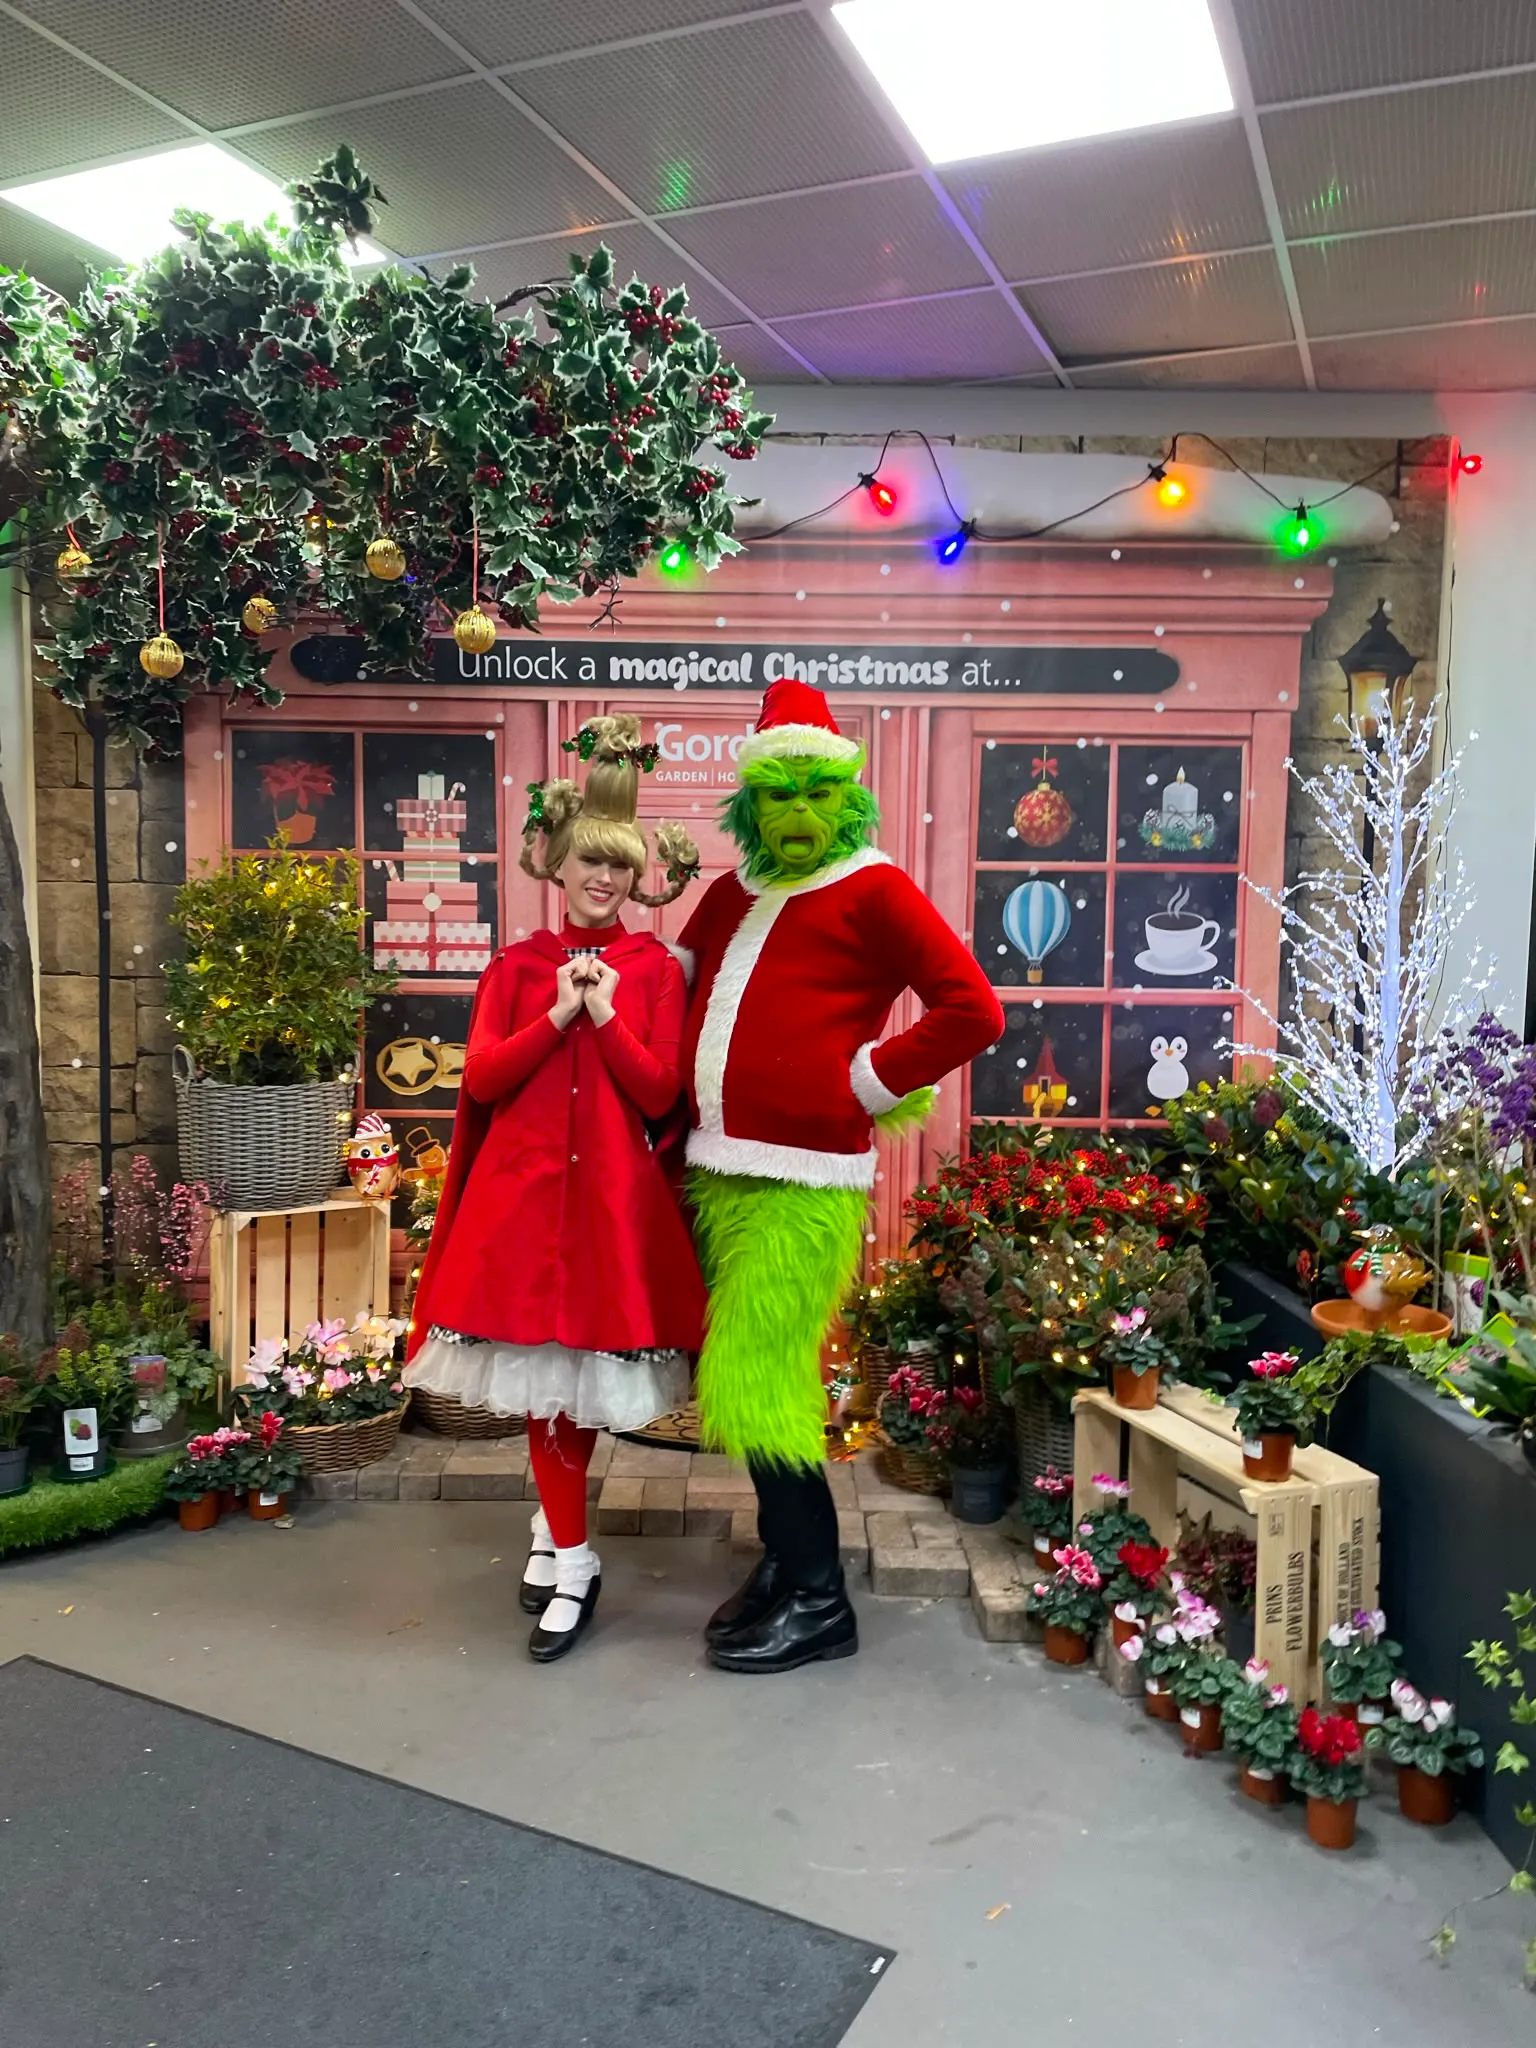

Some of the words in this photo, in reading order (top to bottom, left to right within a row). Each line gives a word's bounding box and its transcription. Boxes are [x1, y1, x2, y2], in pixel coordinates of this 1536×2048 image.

[458, 645, 568, 680] Unlock
[578, 656, 596, 680] a
[609, 651, 753, 692] magical
[763, 652, 949, 686] Christmas
[961, 658, 1021, 687] at...
[655, 723, 755, 762] Gord
[655, 770, 708, 783] GARDEN
[717, 771, 737, 783] HO
[1265, 1583, 1283, 1625] PRINS
[1286, 1550, 1305, 1653] FLOWERBULBS
